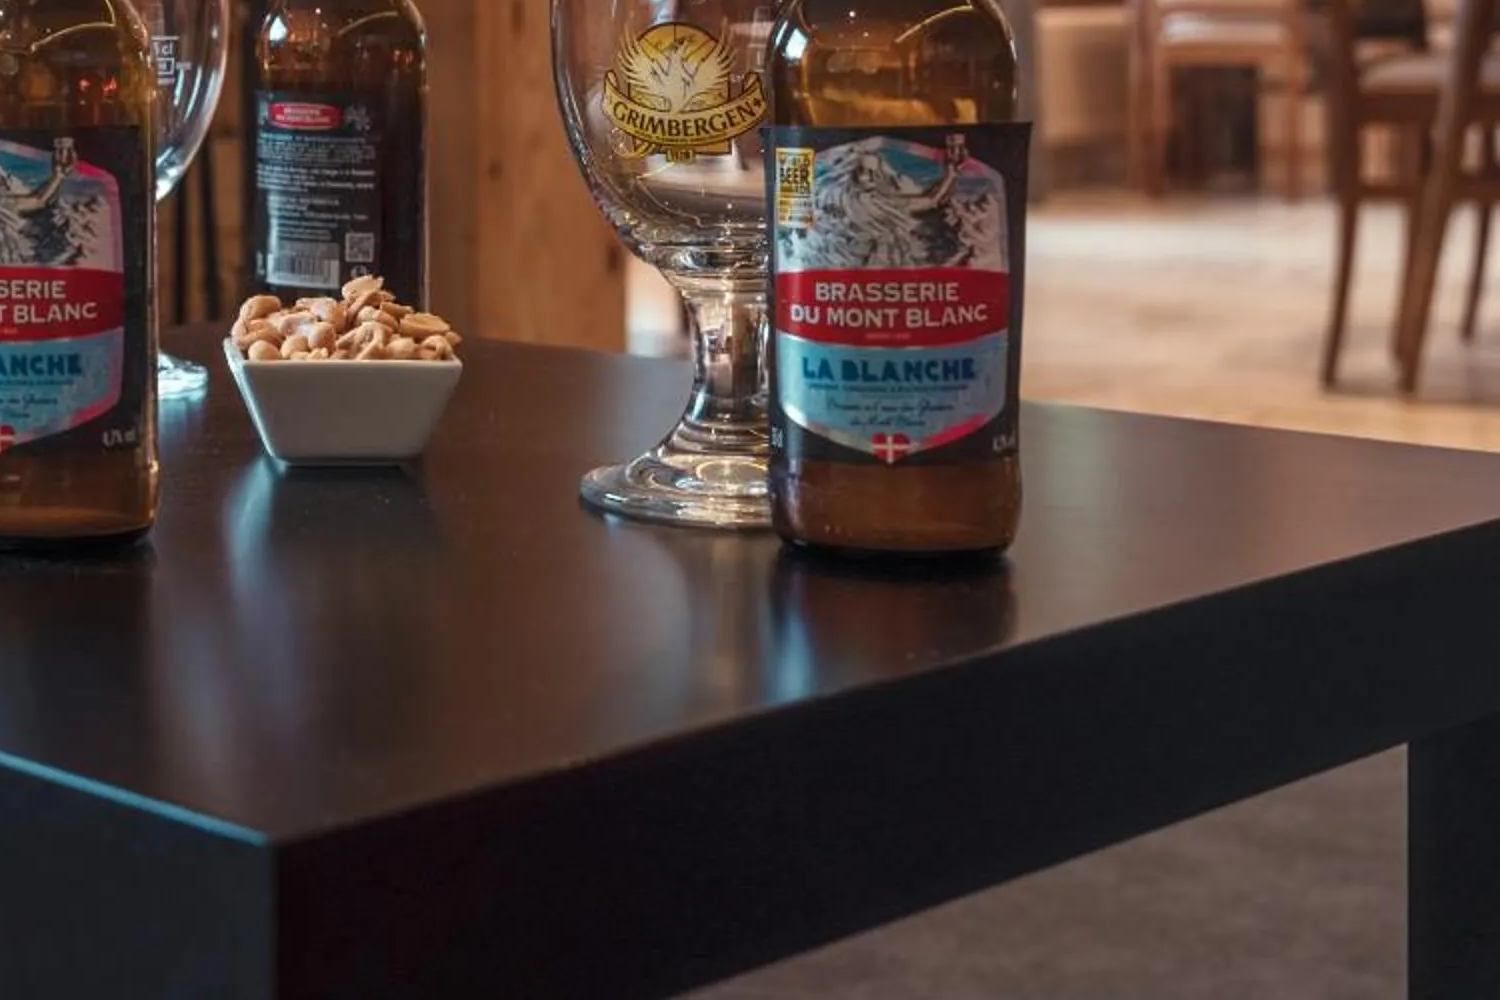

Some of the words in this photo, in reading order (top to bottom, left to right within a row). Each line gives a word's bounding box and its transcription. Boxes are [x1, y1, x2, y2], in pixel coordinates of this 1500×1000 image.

[613, 101, 756, 137] GRIMBERGEN
[815, 282, 960, 302] BRASSERIE
[13, 302, 98, 324] BLANC
[790, 304, 820, 324] DU
[827, 307, 899, 328] MONT
[905, 304, 988, 329] BLANC
[803, 357, 834, 380] LA
[841, 358, 976, 383] BLANCHE
